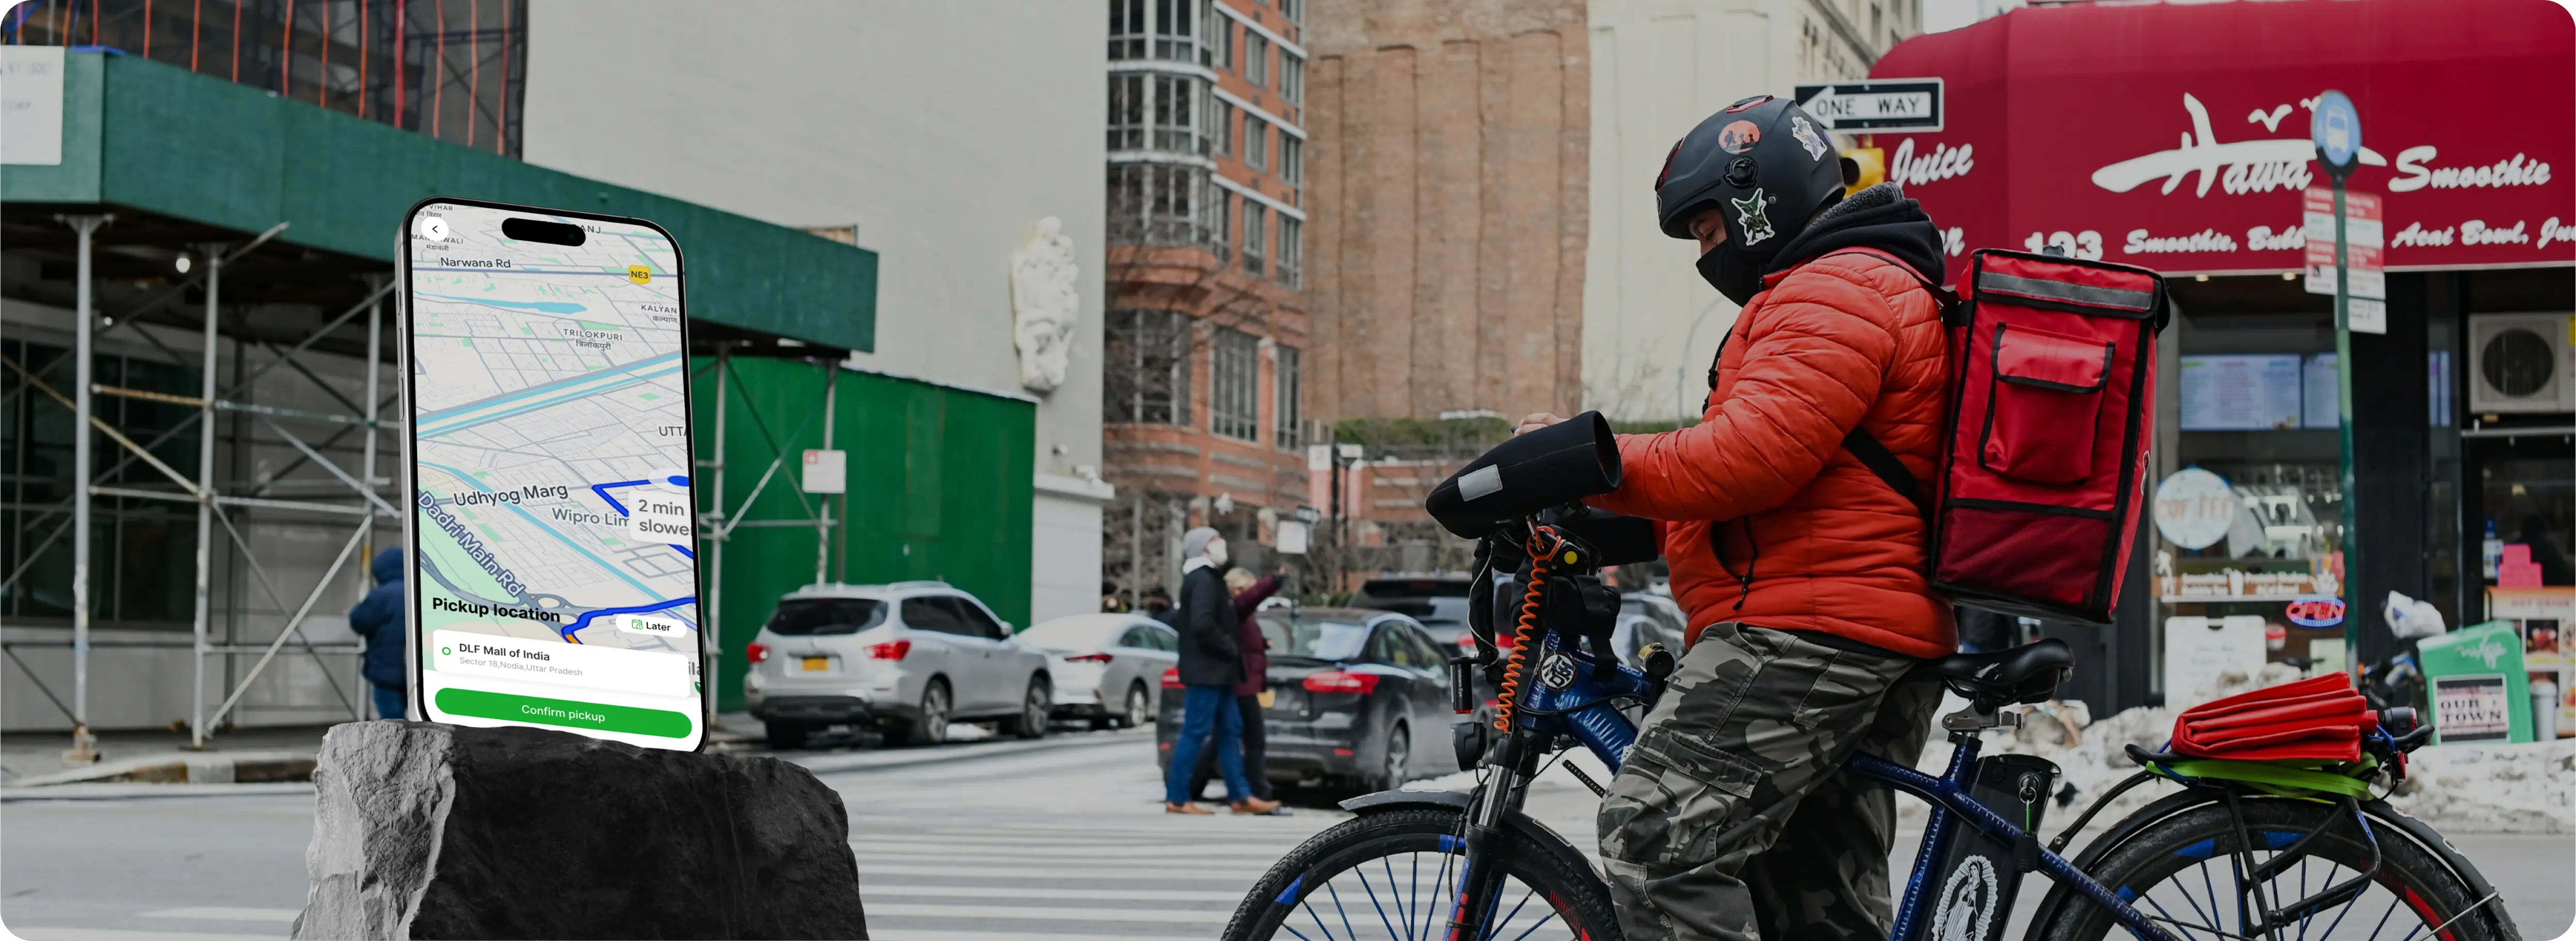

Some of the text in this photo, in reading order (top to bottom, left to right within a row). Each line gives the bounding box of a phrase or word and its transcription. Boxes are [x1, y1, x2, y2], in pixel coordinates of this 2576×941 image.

[1816, 96, 1920, 116] ONE WAY
[1891, 137, 1974, 188] Juice
[2388, 145, 2551, 192] Smoothie
[2123, 228, 2237, 254] Smoothie,
[2391, 221, 2455, 249] Acai
[2460, 219, 2529, 246] Bowl,
[426, 243, 449, 251] मंडावली
[440, 257, 511, 268] Narwana Rd
[631, 270, 649, 279] NE3
[641, 304, 677, 314] KALYAN
[652, 315, 678, 323] कल्याण
[563, 328, 623, 341] TRILOKPURI
[575, 339, 611, 352] त्रिलोकपुरी
[658, 426, 687, 436] UTT
[453, 485, 568, 507] Udhyog Marg
[552, 507, 600, 525] Wipro
[638, 499, 684, 516] 2 min
[639, 519, 692, 537] slowe
[418, 492, 525, 597] Dadri Main Rd
[432, 597, 560, 623] Pickup location
[2285, 602, 2346, 621] OPEN
[646, 621, 671, 631] Later
[459, 643, 550, 661] DLF Mall of India
[459, 657, 583, 676] Sector 18,Nodia,Uttar Pradesh
[2440, 699, 2479, 709] OUR
[522, 705, 605, 723] Confirm pickup
[2442, 710, 2502, 722] TOWN
